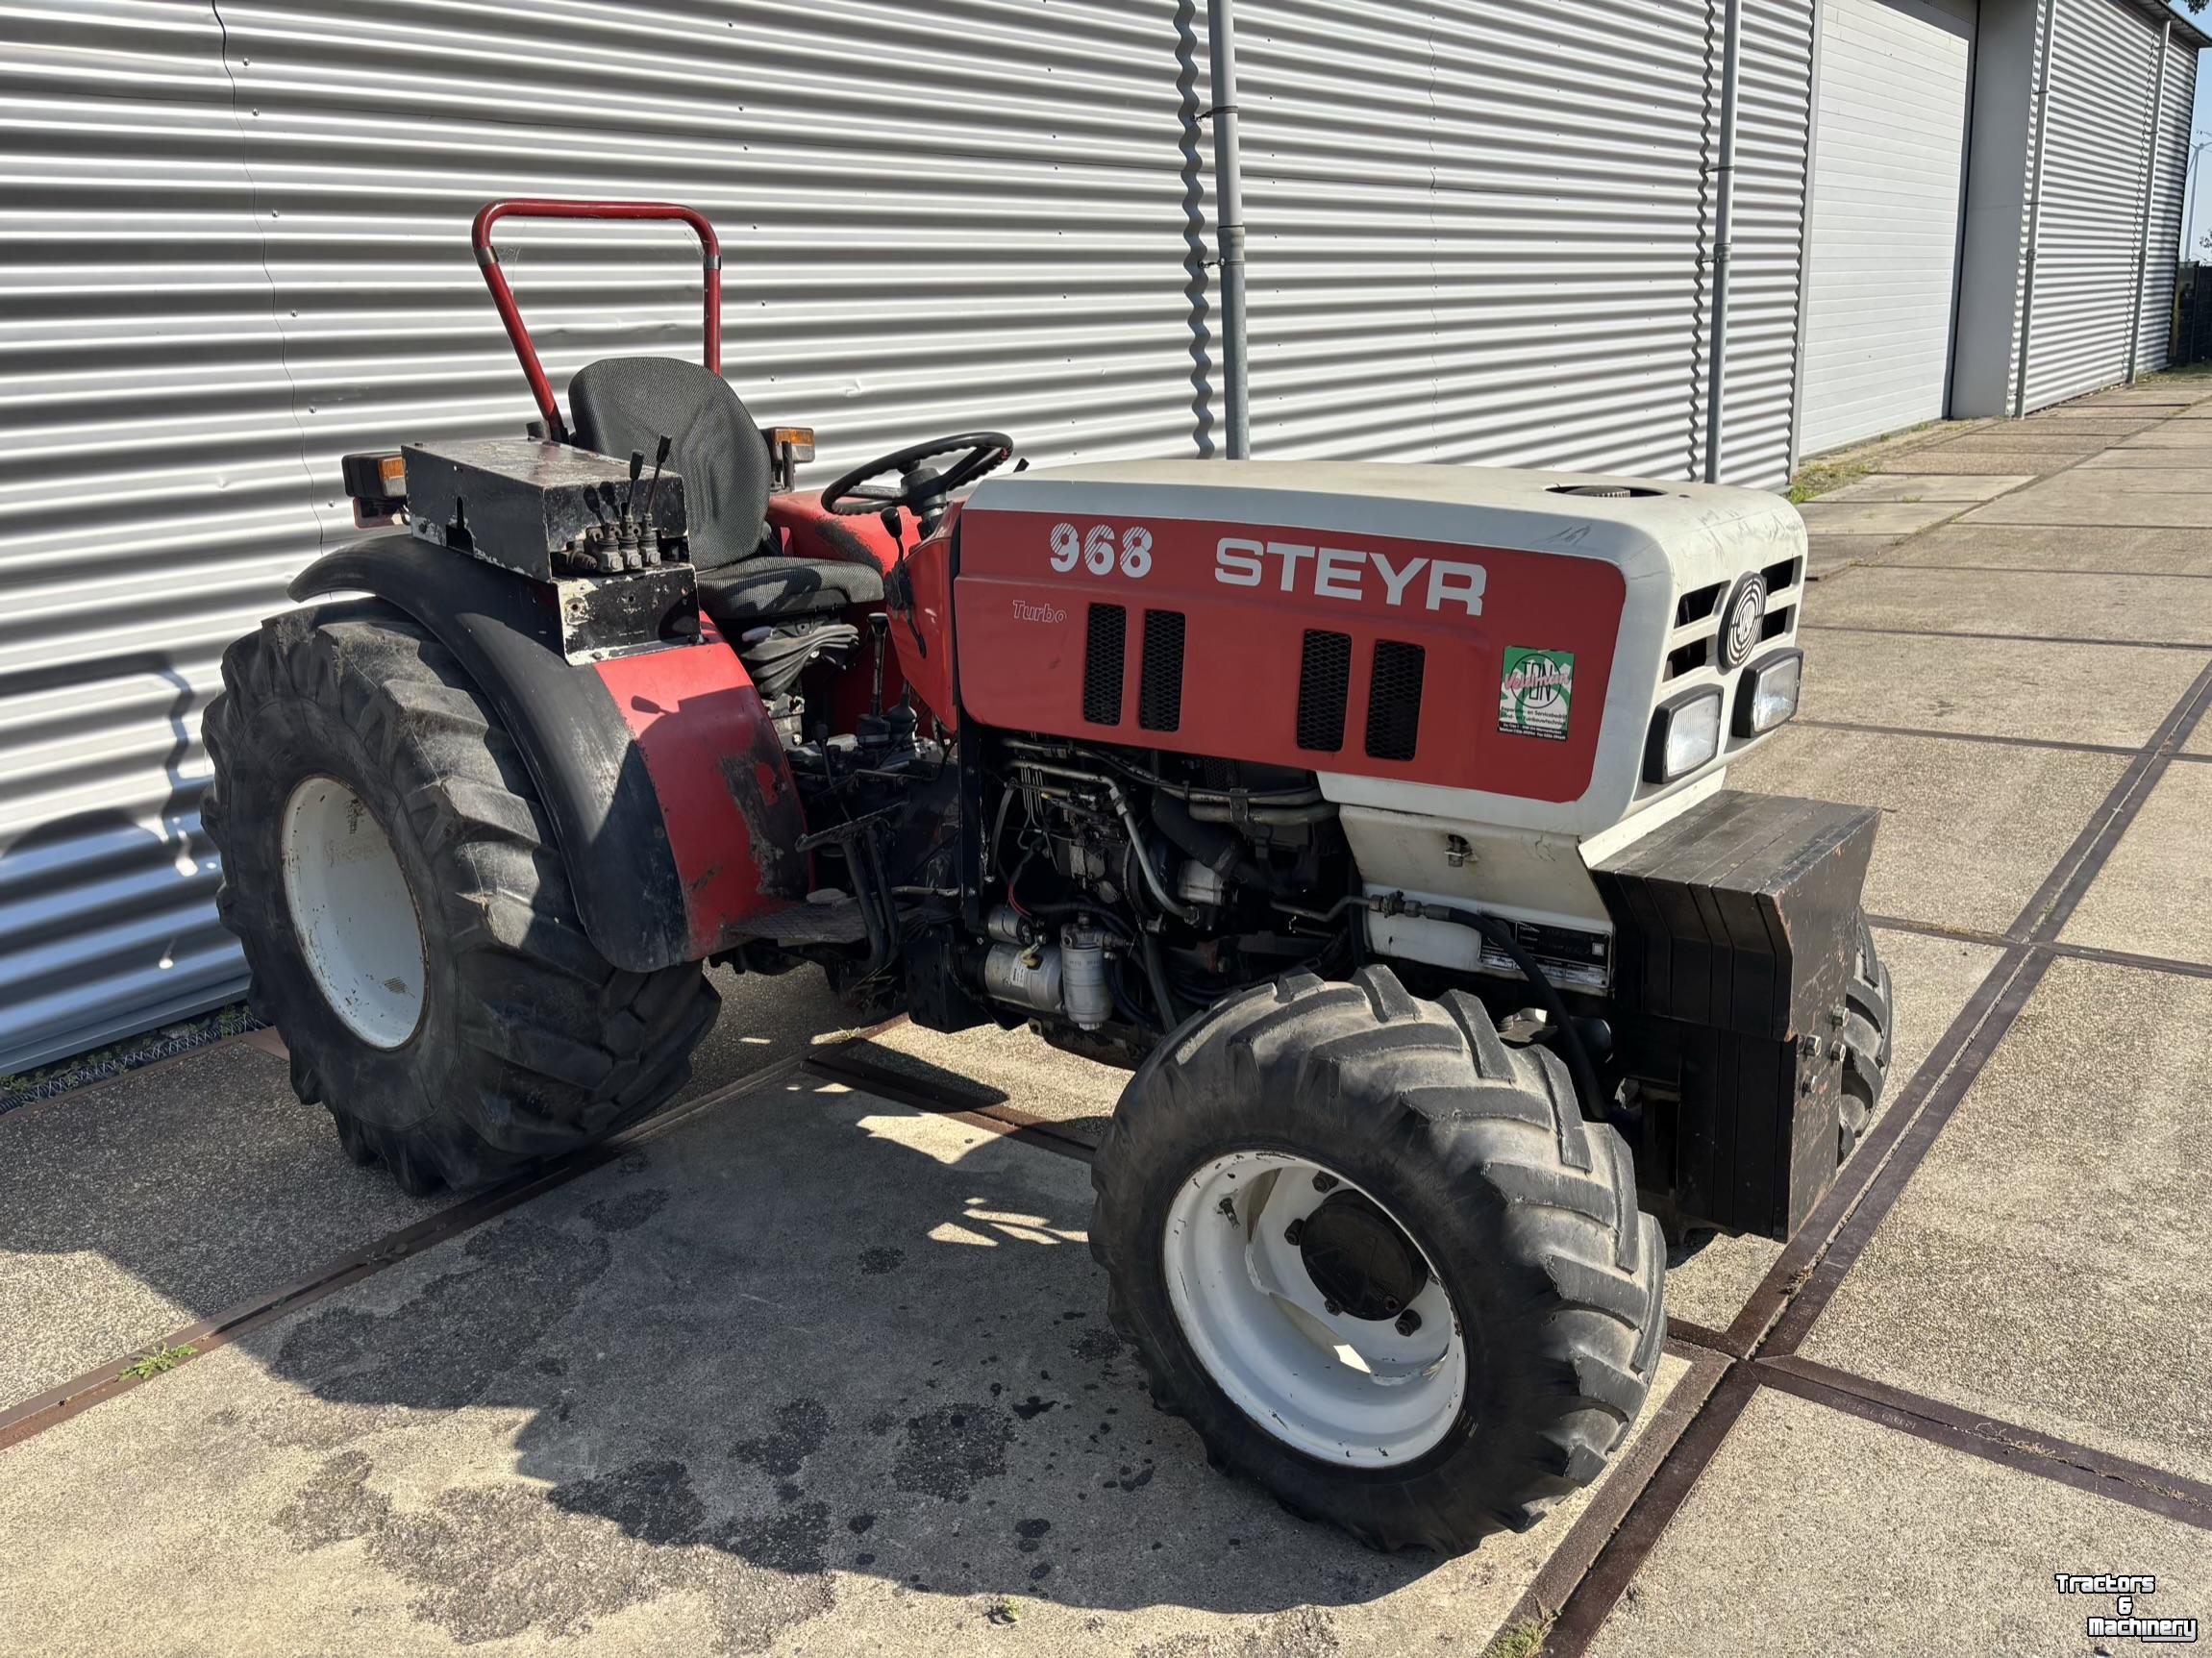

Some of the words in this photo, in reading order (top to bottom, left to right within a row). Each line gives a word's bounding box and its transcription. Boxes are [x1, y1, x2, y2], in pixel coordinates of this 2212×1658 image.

[1050, 522, 1153, 579] 968
[1215, 537, 1487, 616] STEYR
[1012, 599, 1067, 623] Turbo
